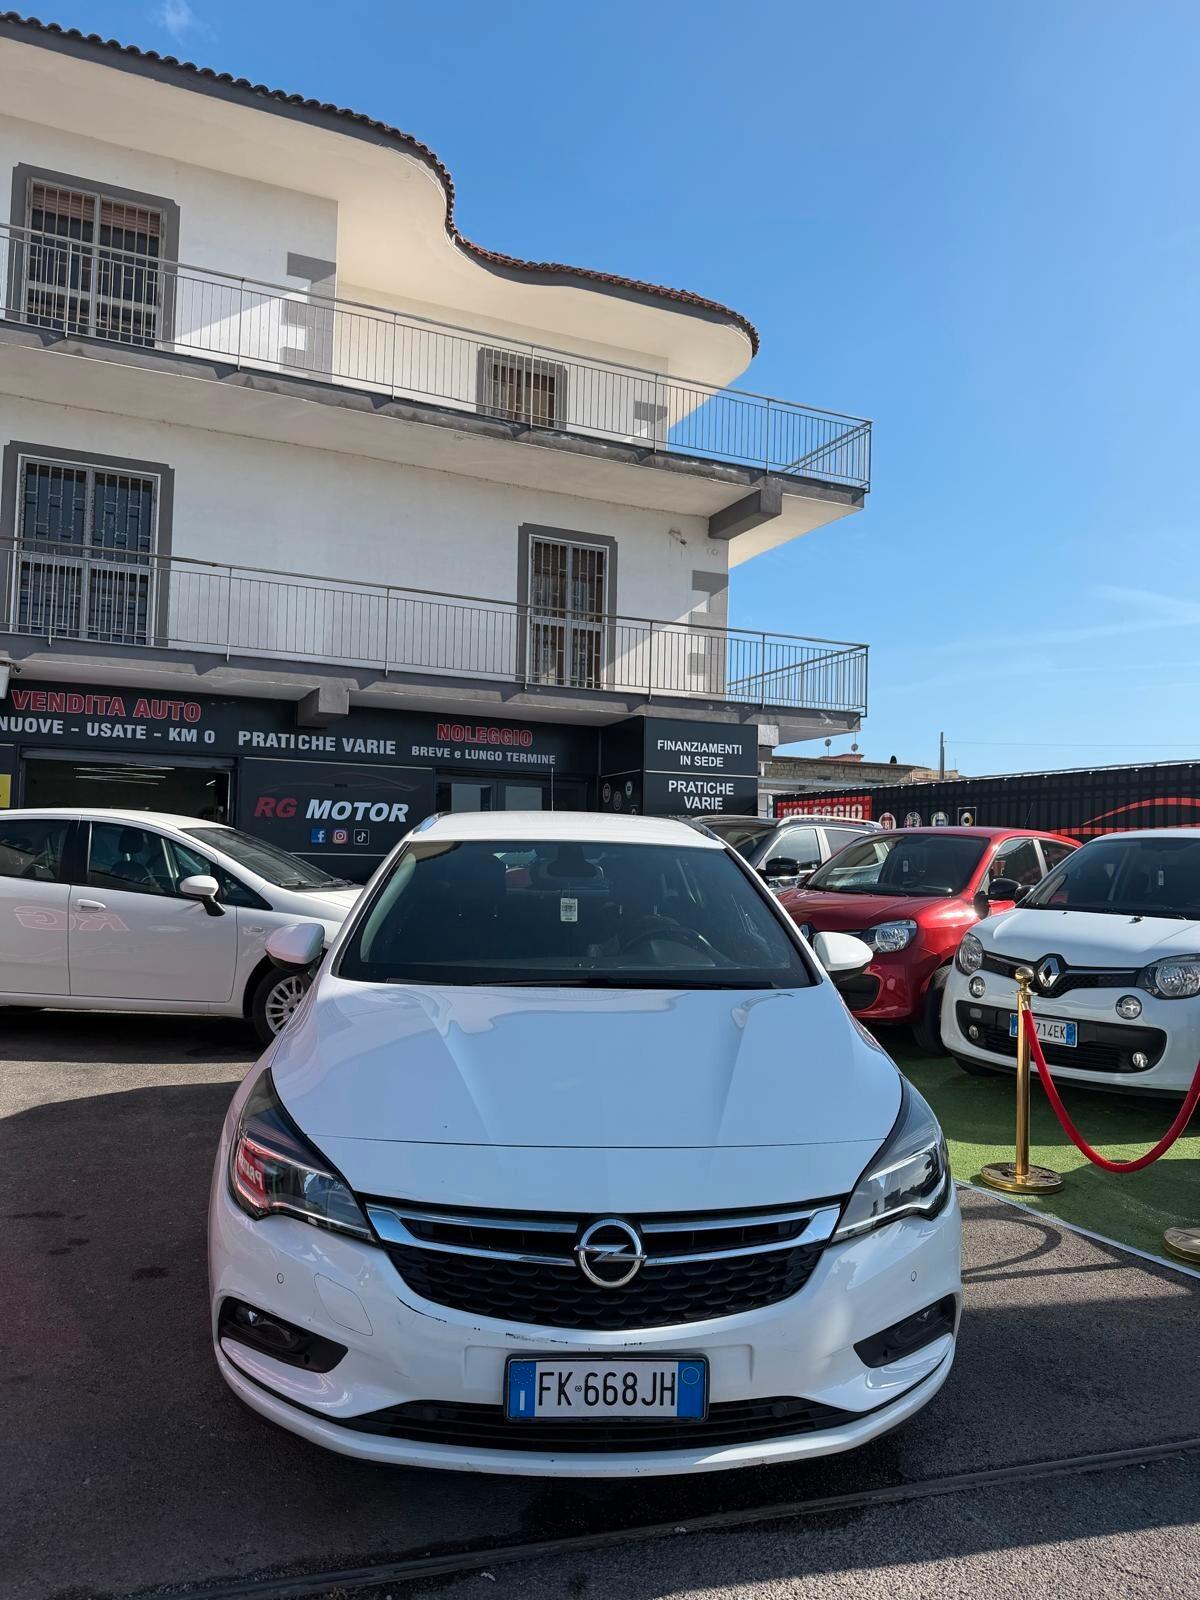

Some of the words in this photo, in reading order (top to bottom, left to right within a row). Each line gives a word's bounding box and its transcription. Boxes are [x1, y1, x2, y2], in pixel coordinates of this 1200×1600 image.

[11, 689, 126, 717] VENDITA
[133, 698, 202, 723] AUTO
[0, 716, 64, 735] NUOVE
[87, 721, 147, 740] USATE
[169, 727, 197, 743] KM
[436, 723, 533, 748] NOLEGGIO
[238, 730, 336, 752] PRATICHE
[343, 738, 396, 755] VARIE
[657, 739, 742, 755] FINANZIAMENTI
[411, 745, 450, 759] BREVE
[454, 750, 461, 759] e
[465, 749, 502, 762] LUNGO
[506, 752, 556, 765] TERMINE
[680, 754, 691, 766] IN
[694, 756, 724, 767] SEDE
[668, 780, 734, 795] PRATICHE
[254, 797, 297, 818] RG
[306, 799, 409, 823] MOTOR
[683, 796, 723, 810] VARIE
[1035, 1022, 1066, 1039] 714EK
